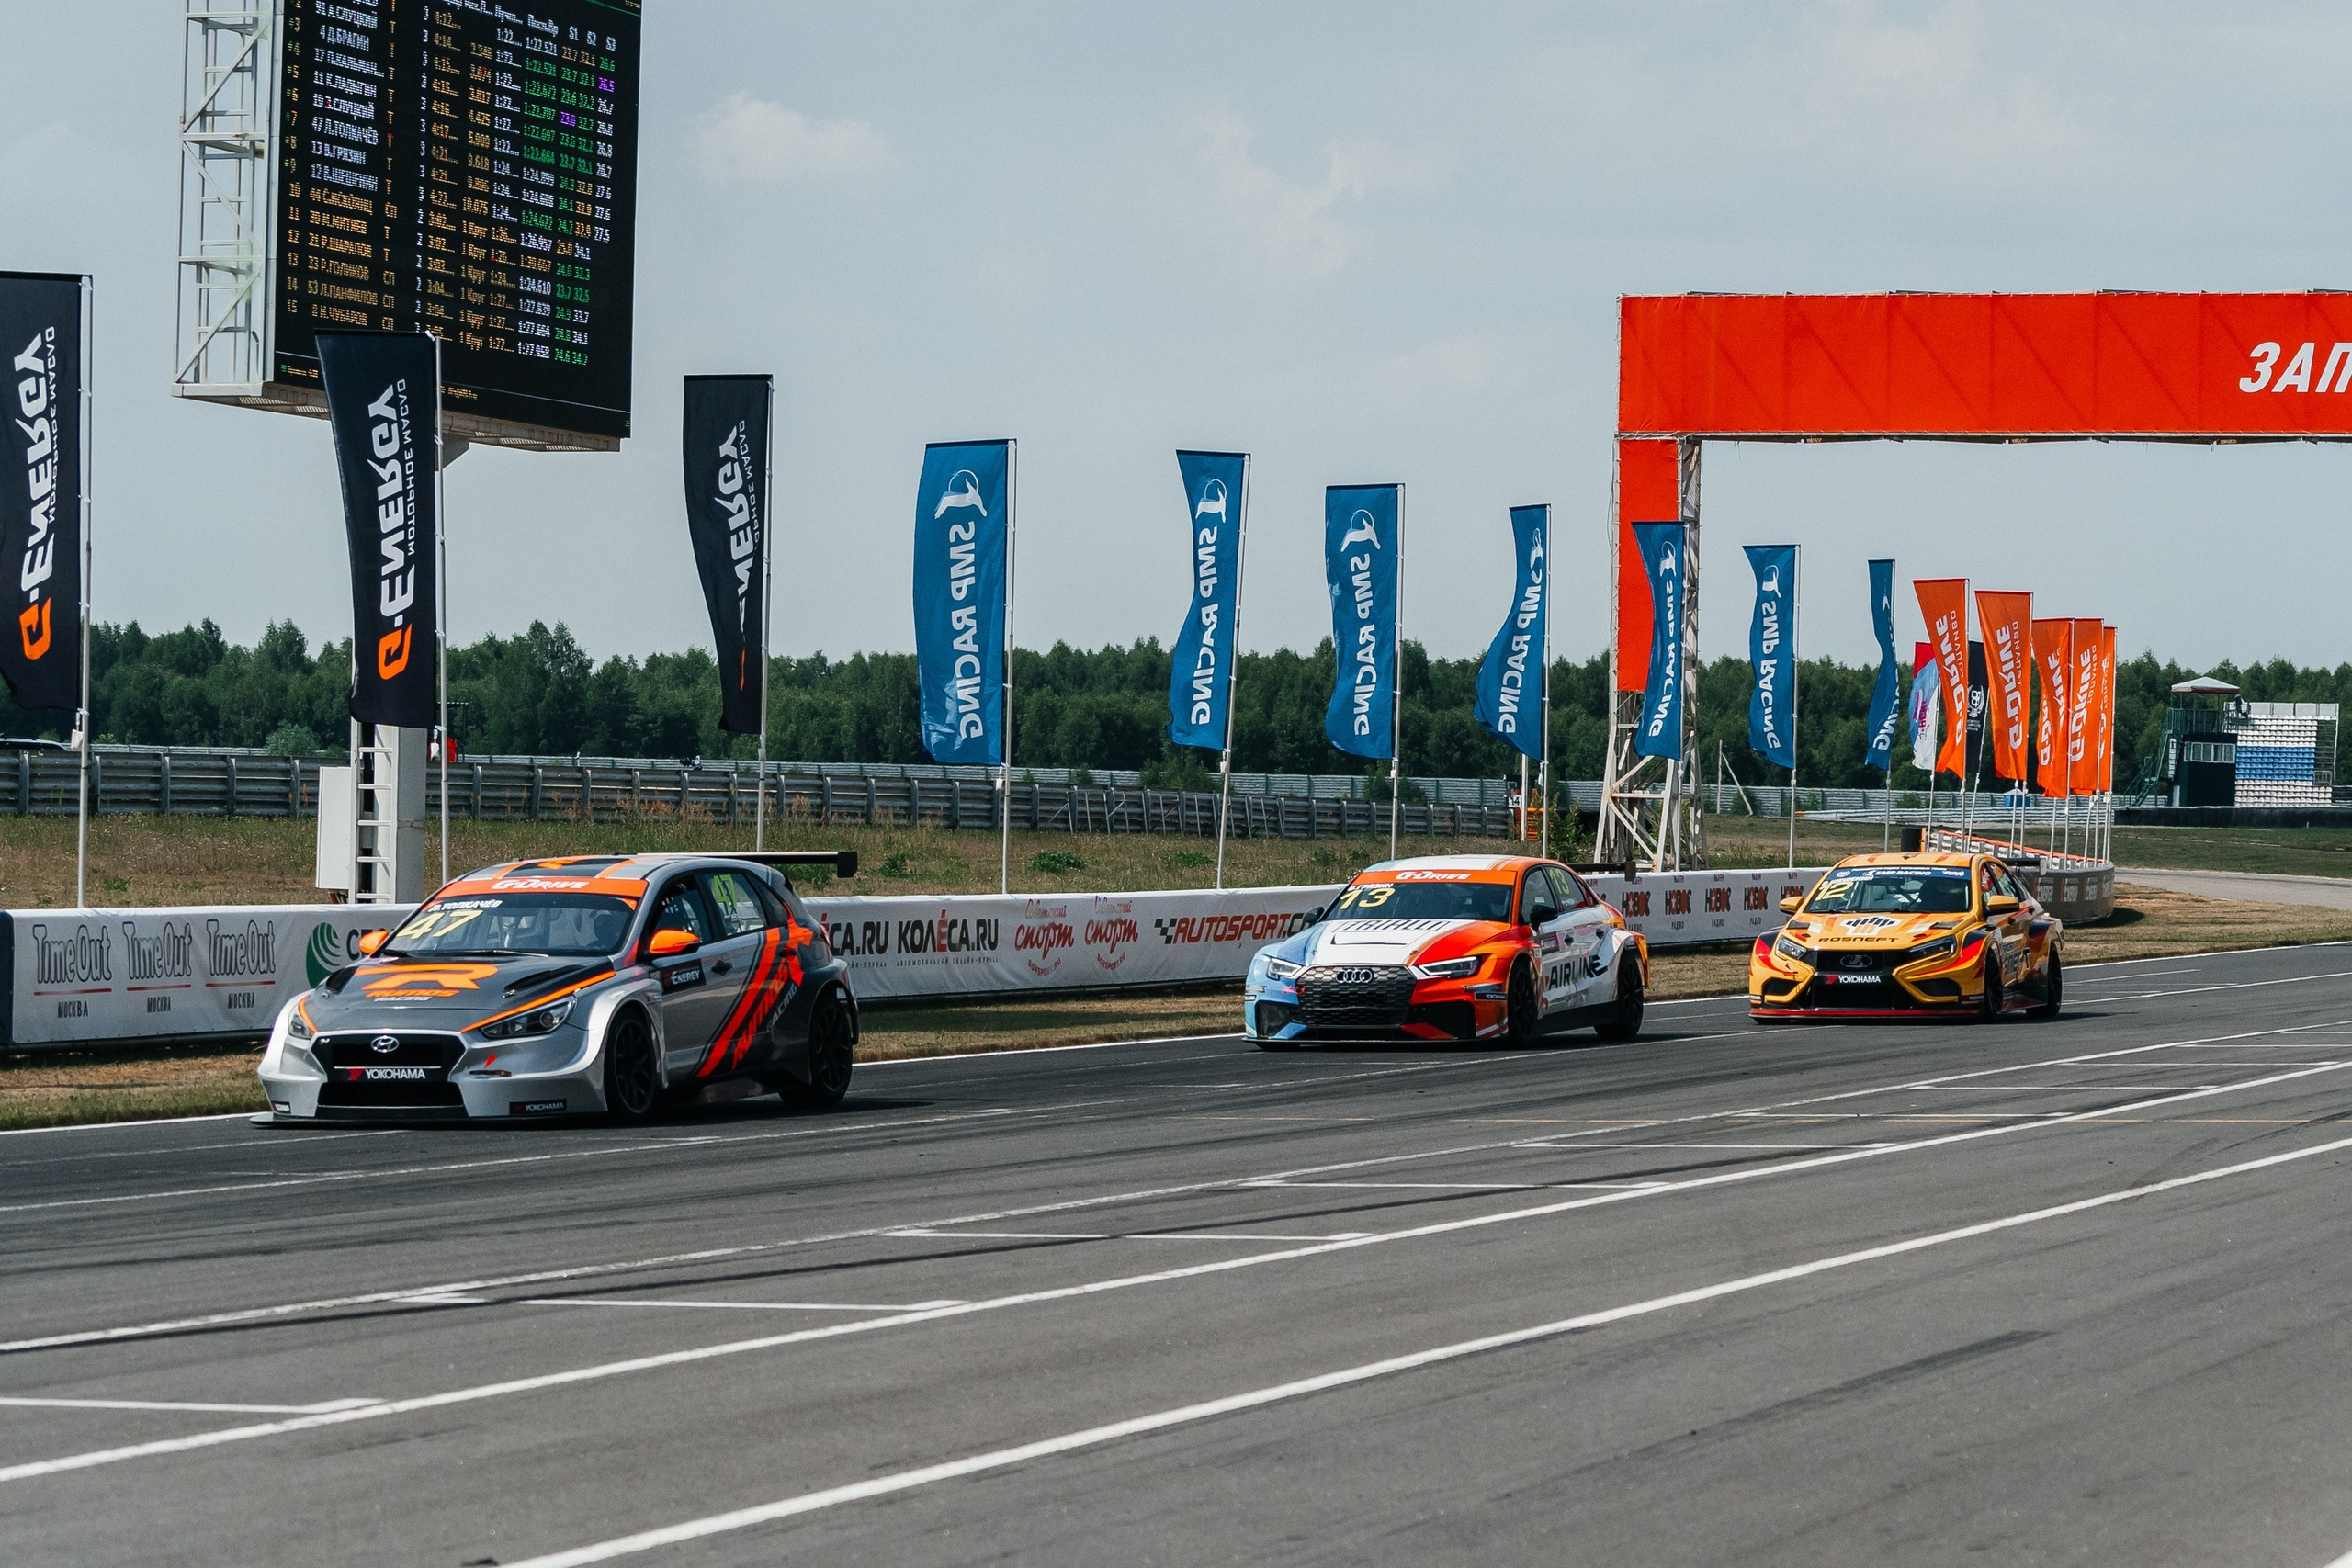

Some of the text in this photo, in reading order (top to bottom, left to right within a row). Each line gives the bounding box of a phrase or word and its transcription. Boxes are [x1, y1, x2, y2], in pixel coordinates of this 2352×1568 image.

[292, 17, 300, 31] 3
[319, 24, 325, 39] 4
[326, 26, 369, 51] Д.БРАГИН
[389, 20, 396, 33] Т
[568, 25, 616, 51] S1 S2 S3
[291, 42, 300, 55] 4
[313, 47, 325, 62] 17
[388, 66, 395, 79] Т
[291, 87, 298, 101] 6
[387, 110, 393, 123] Т
[292, 64, 299, 78] 5
[312, 70, 324, 85] 11
[387, 88, 394, 102] Т
[596, 141, 612, 157] 26.8
[290, 109, 489, 170] 7 47 Л.ТОЛКАЧЁВ 9.618
[311, 140, 392, 170] 13 В.ГРЯЗИН Т
[288, 181, 300, 197] 10
[309, 187, 321, 201] 44
[384, 201, 397, 218] СП
[311, 163, 322, 179] 12
[385, 178, 391, 194] Т
[594, 226, 610, 243] 27.5
[288, 206, 300, 220] 11
[383, 225, 390, 239] Т
[288, 229, 299, 243] 12
[383, 247, 390, 261] Т
[519, 276, 551, 295] 1:24.610
[555, 283, 571, 299] 23.7
[573, 287, 589, 302] 32.5
[287, 276, 394, 308] 14 53 Л.ПАНФИЛОВ СП
[288, 252, 298, 265] 13
[308, 255, 319, 269] 33
[320, 257, 368, 280] Р.ГОЛИКОВ
[382, 270, 394, 285] СП
[572, 309, 589, 323] 33.7
[287, 299, 297, 312] 15
[381, 316, 393, 330] СП
[2239, 341, 2352, 393] ЗАП
[712, 874, 737, 908] 47
[1548, 869, 1570, 895] 13
[1815, 881, 1854, 902] 12
[428, 898, 503, 912] Л.ТОЛКАЧЁВ
[1340, 887, 1396, 910] 13
[395, 909, 483, 939] 47
[1548, 954, 1609, 991] AIRLINE
[1838, 975, 1881, 984] YOKOHAMA
[58, 1000, 89, 1018] МОСКВА
[147, 996, 171, 1012] МОСКВА
[227, 992, 255, 1009] МОСКВА
[366, 1068, 425, 1079] YOKOHAMA
[525, 1102, 565, 1111] YOKOHAMA
